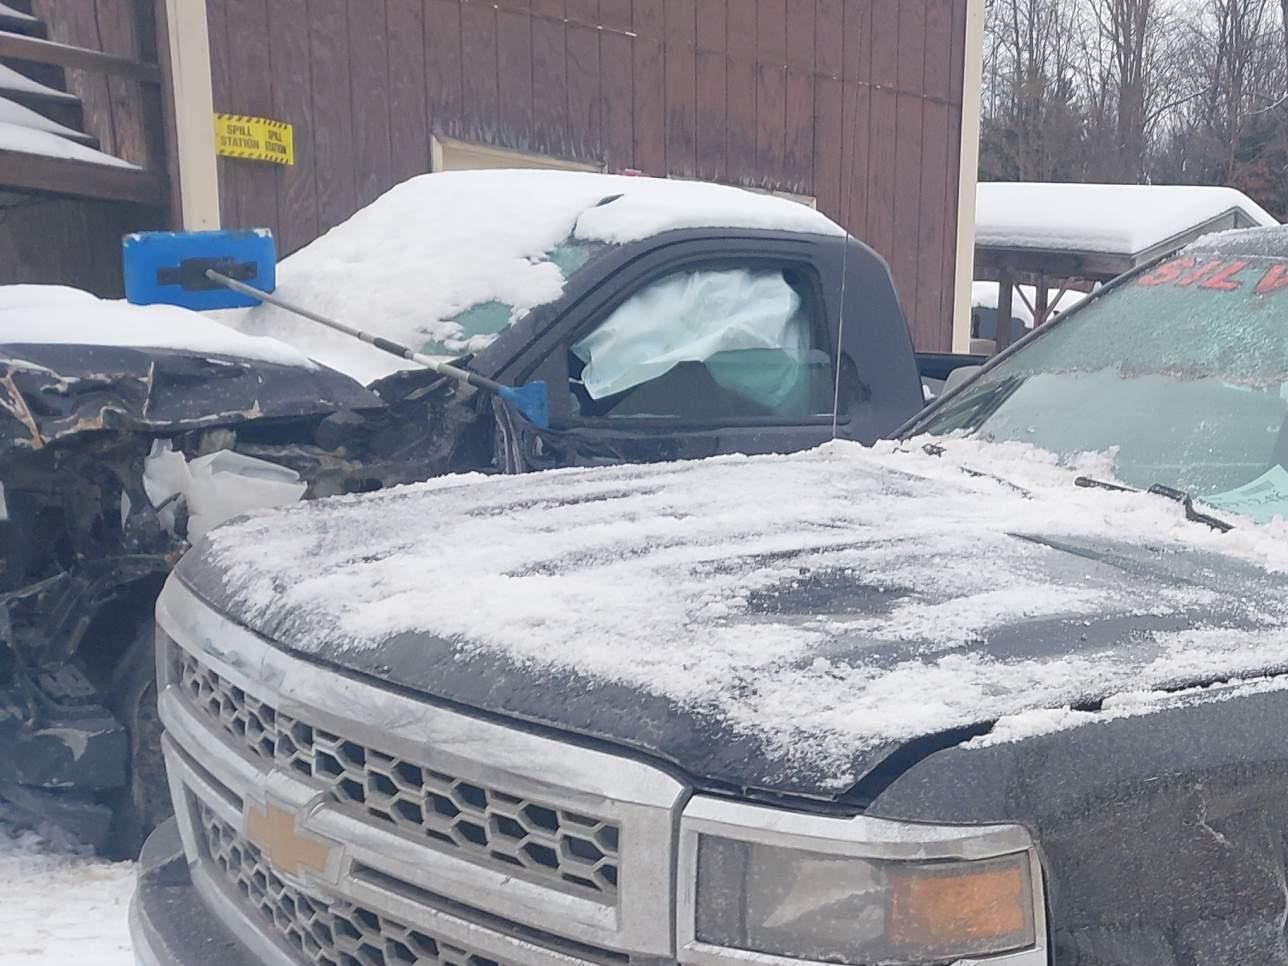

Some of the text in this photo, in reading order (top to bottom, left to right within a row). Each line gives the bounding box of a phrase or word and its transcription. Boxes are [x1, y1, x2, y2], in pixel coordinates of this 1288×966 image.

[227, 125, 253, 136] SPILL
[267, 129, 282, 142] SPILL
[220, 136, 260, 149] STATION
